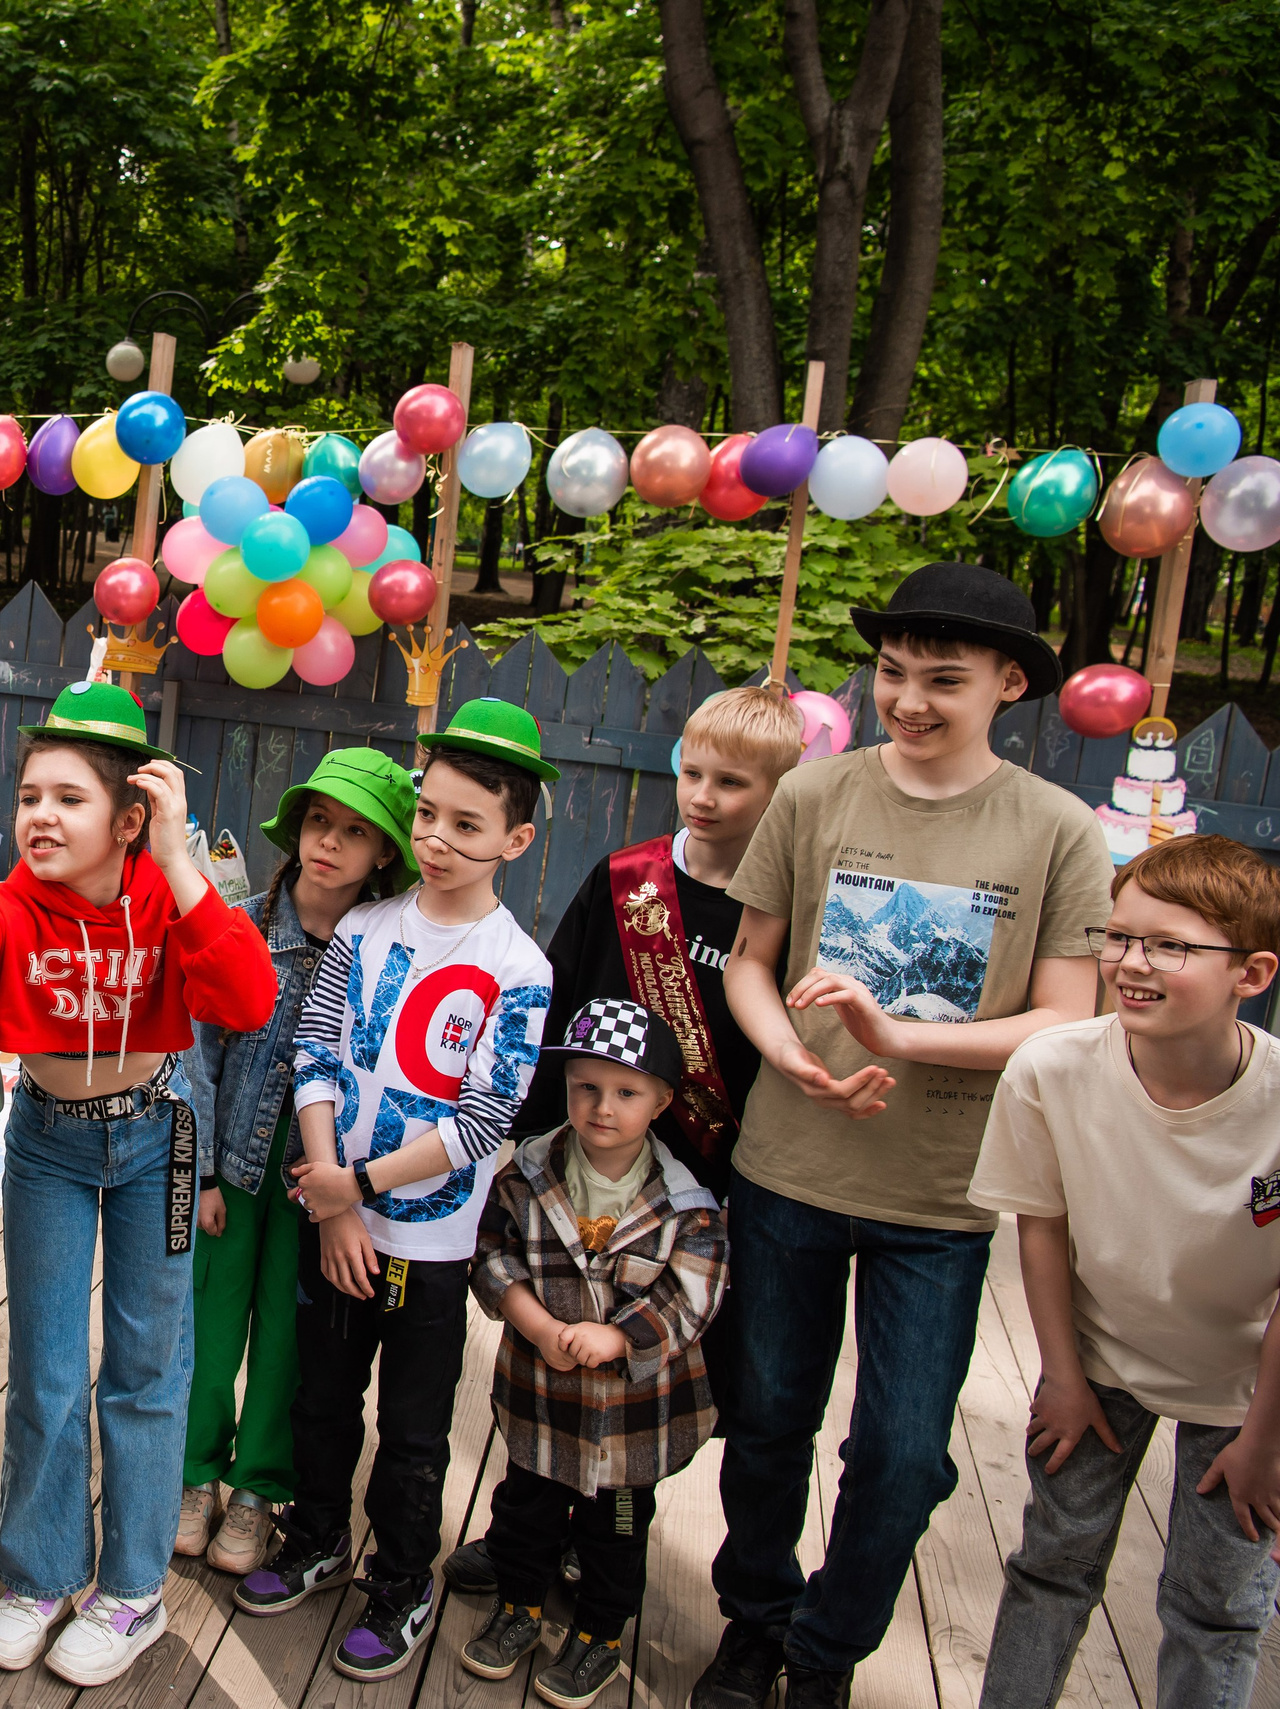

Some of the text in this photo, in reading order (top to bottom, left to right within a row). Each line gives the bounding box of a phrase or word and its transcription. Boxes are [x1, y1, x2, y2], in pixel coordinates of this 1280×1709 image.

[856, 861, 870, 870] THE
[835, 872, 895, 892] MOUNTAIN
[975, 880, 1020, 896] THE WORLD
[972, 892, 1009, 906] IS YOURS
[971, 904, 1017, 921] TO EXPLORE
[638, 952, 670, 1026] начально
[49, 987, 144, 1022] DAY
[440, 1039, 468, 1056] KAP
[926, 1090, 958, 1100] EXPLORE
[961, 1092, 978, 1102] THIS
[171, 1168, 192, 1251] SUPREME
